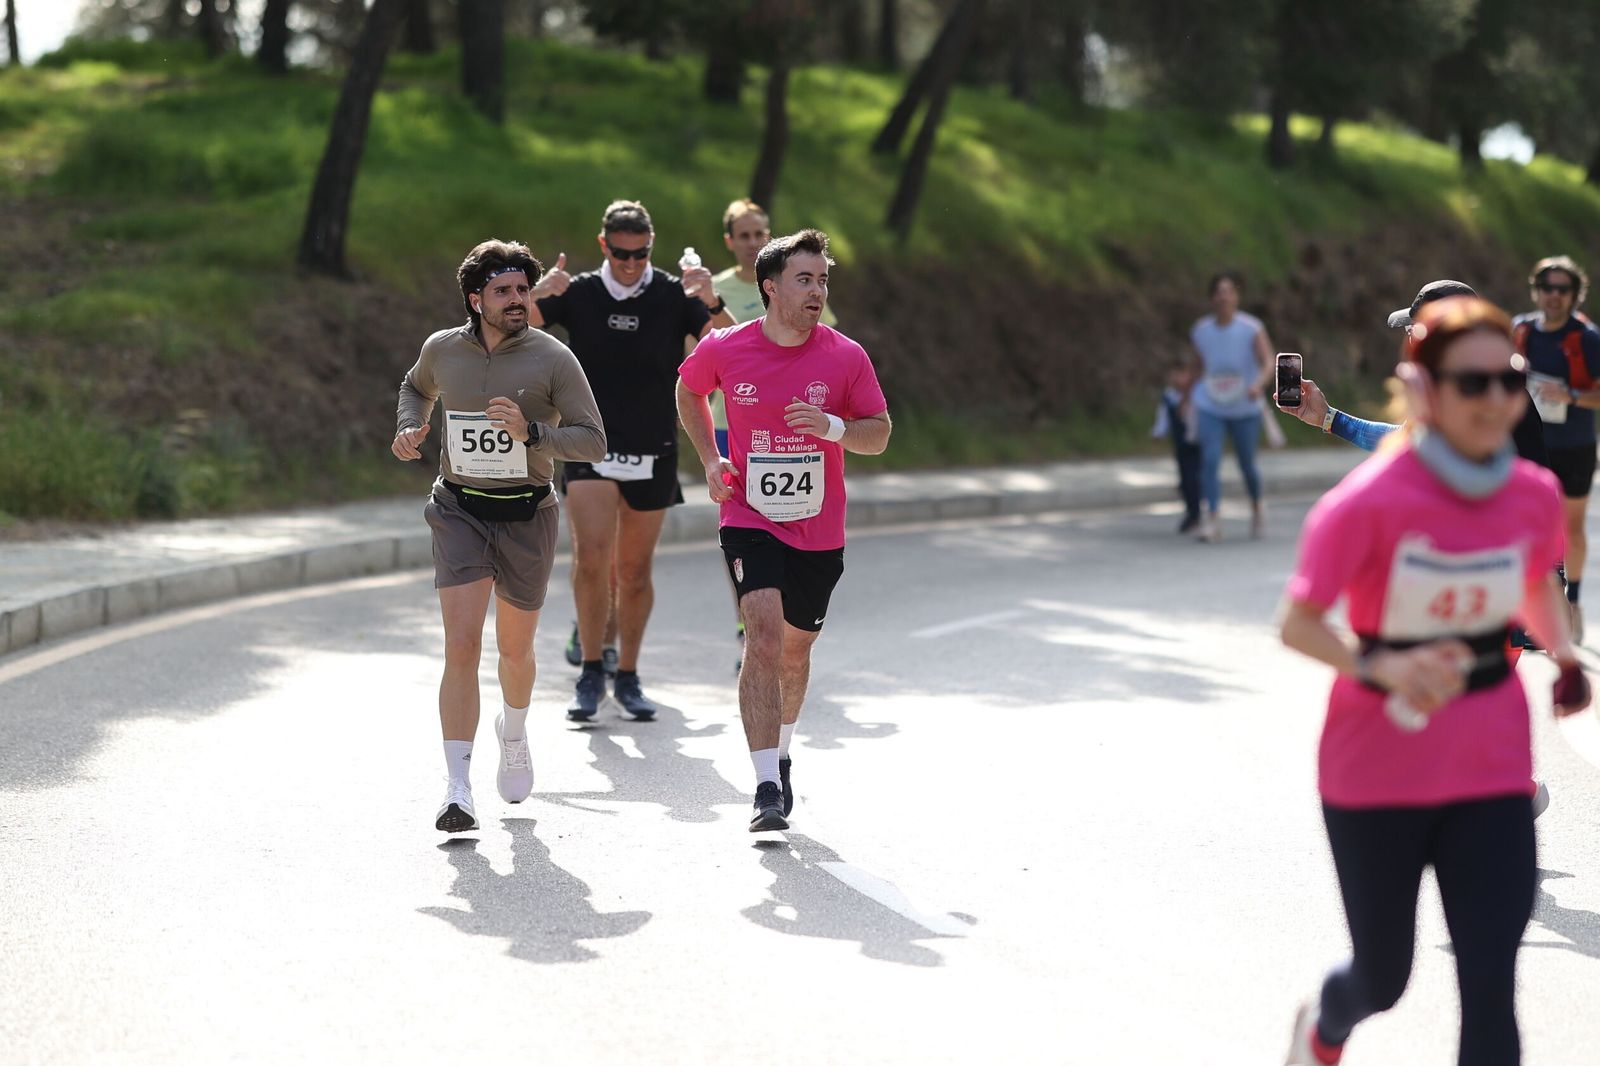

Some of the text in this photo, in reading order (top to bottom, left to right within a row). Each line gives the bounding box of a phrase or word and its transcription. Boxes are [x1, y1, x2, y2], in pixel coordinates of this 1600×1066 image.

[462, 429, 514, 454] 569
[774, 435, 805, 443] Ciudad
[787, 443, 817, 453] Málaga
[760, 471, 814, 497] 624
